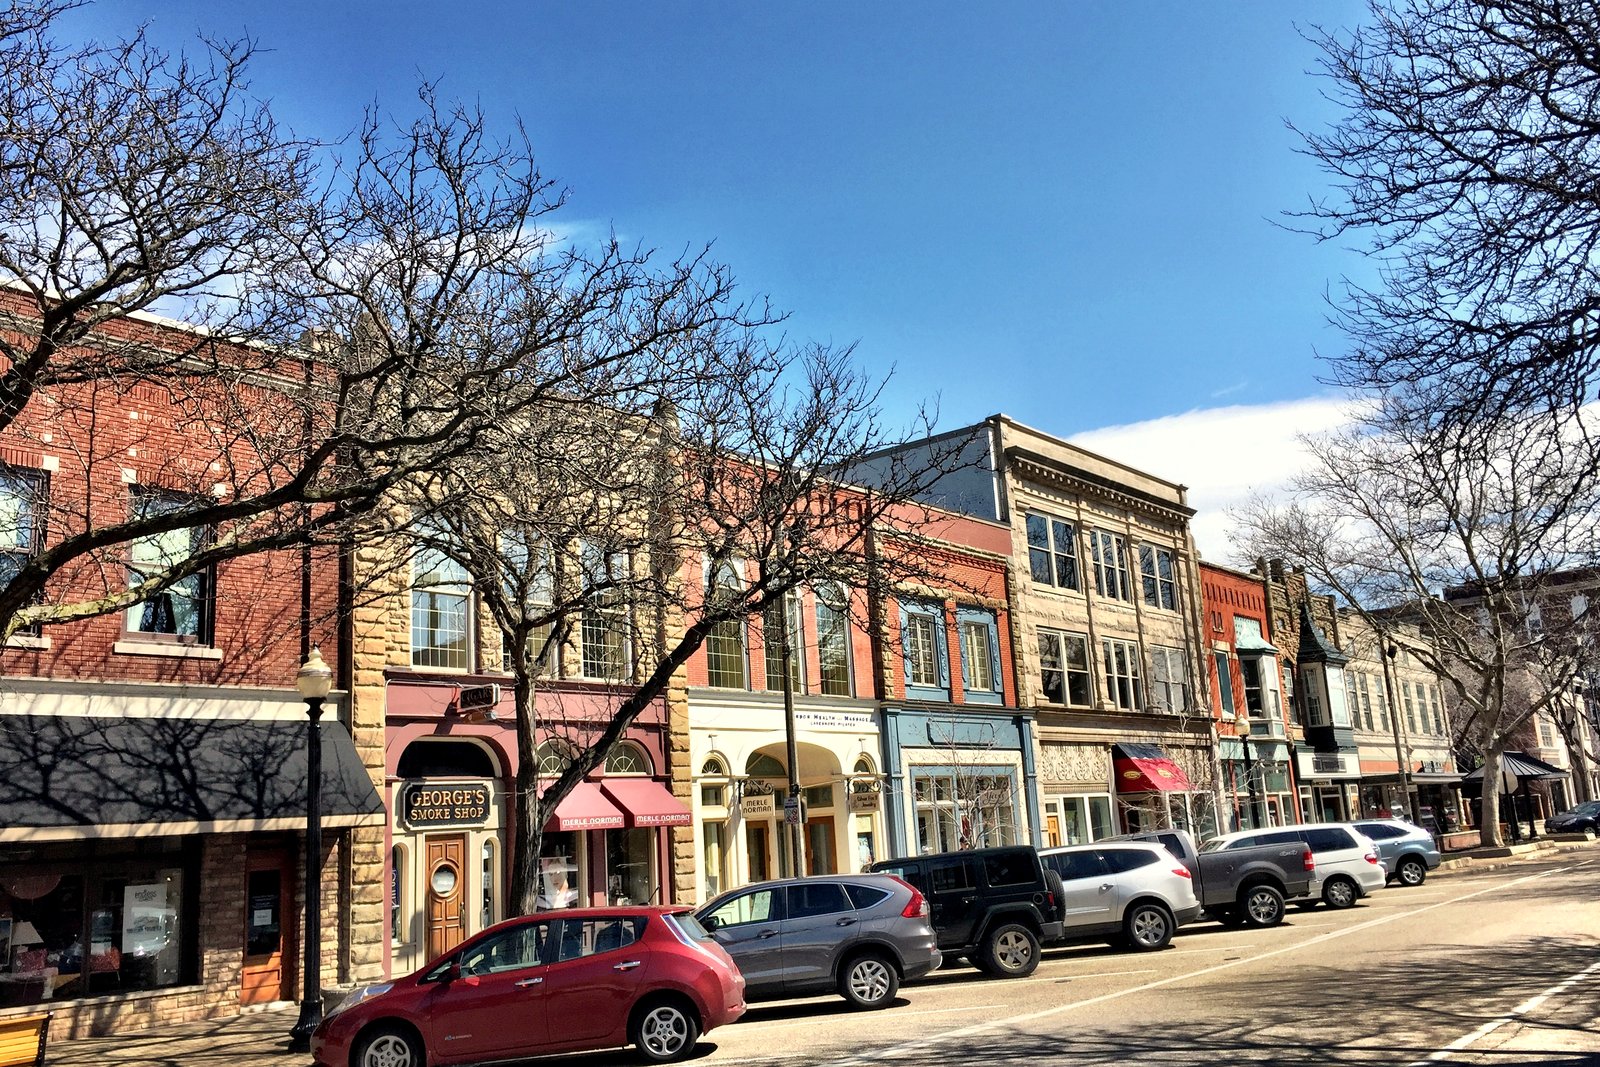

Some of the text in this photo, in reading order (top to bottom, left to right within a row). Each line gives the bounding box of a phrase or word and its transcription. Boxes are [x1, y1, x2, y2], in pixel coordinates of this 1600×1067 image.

[410, 789, 485, 807] GEORGE'S
[746, 799, 768, 807] MERLE
[410, 807, 484, 820] SMOKE SHOP
[589, 816, 622, 824] NORMAN
